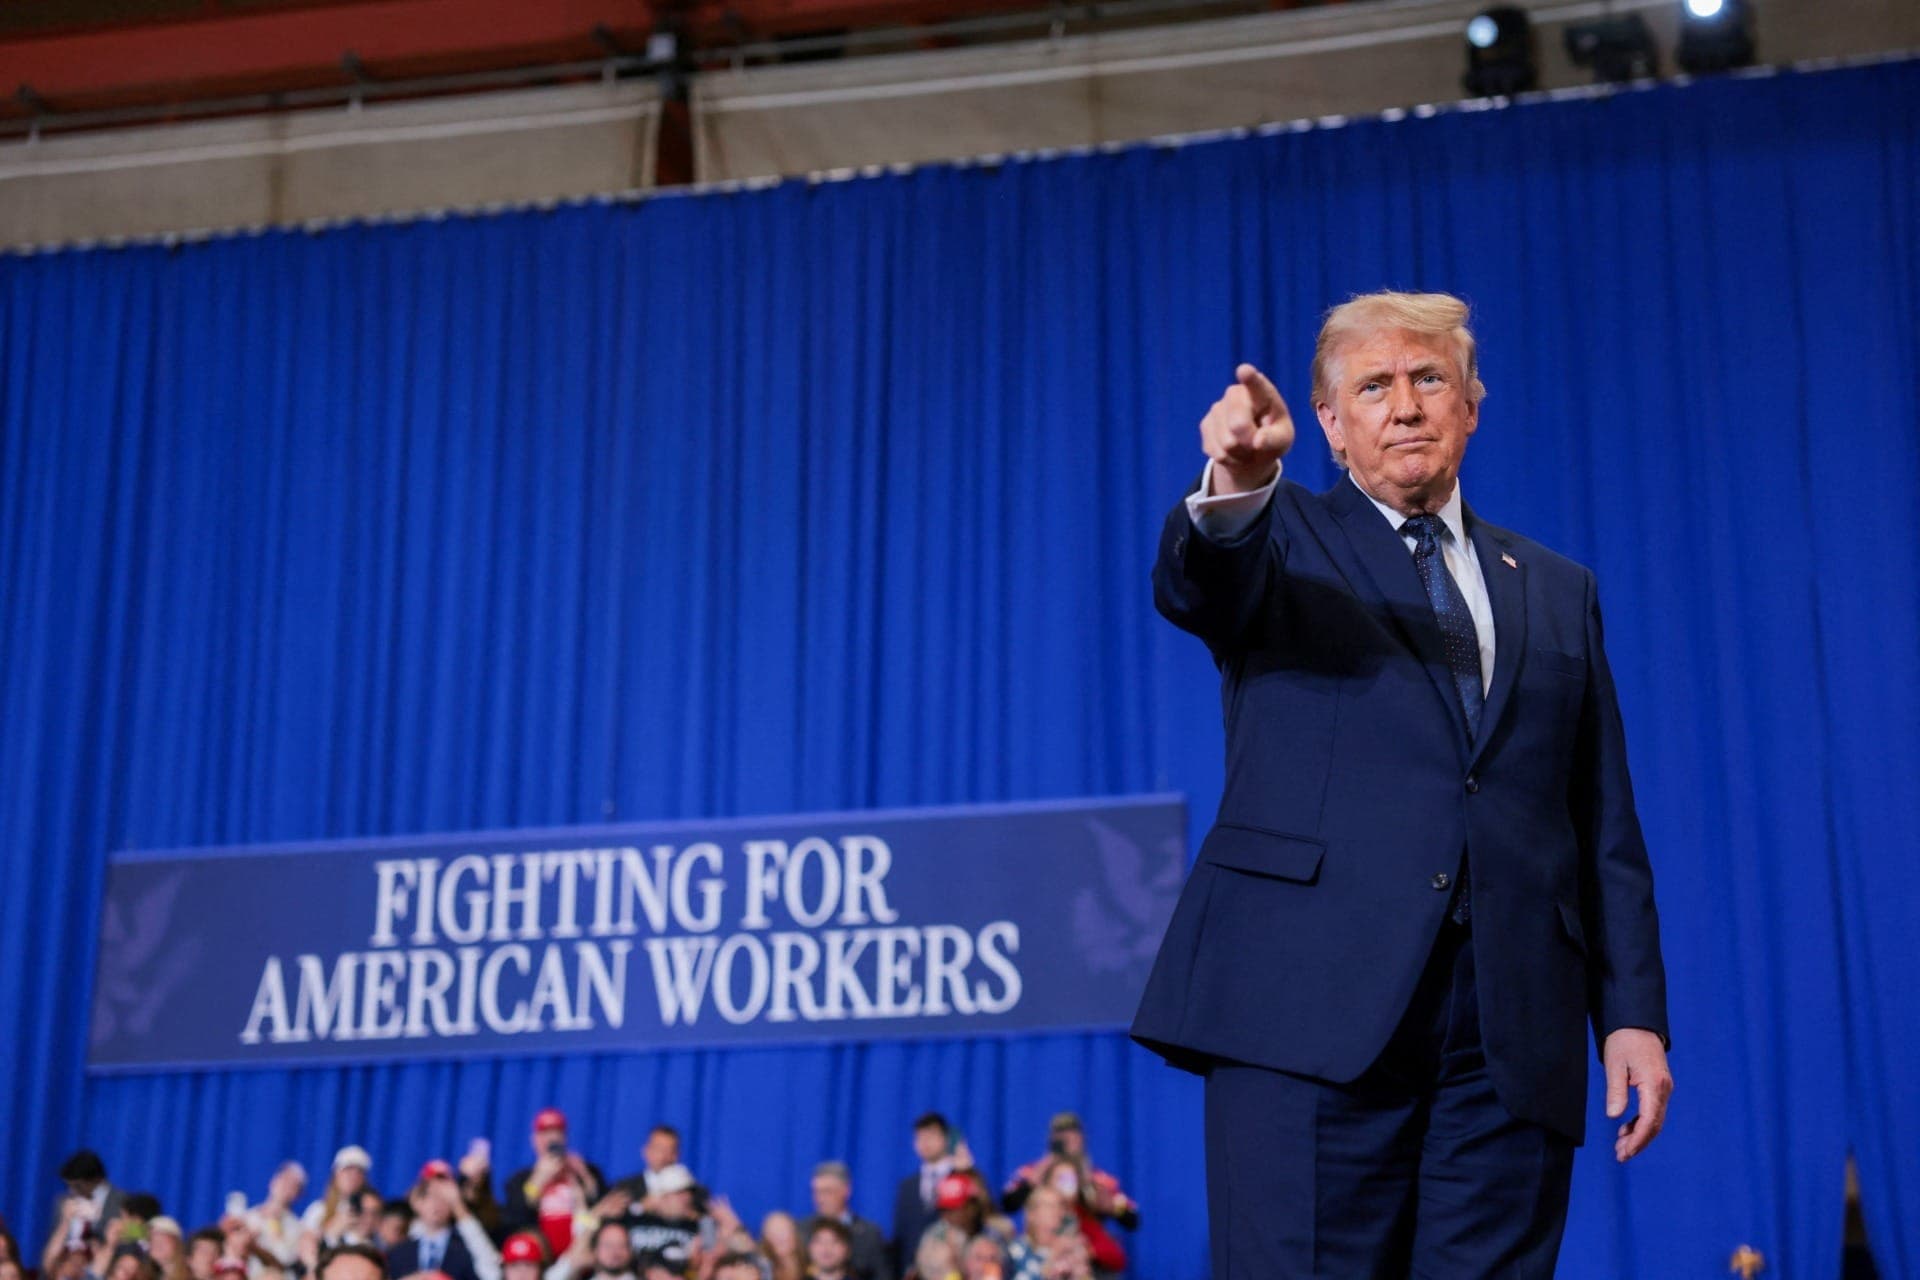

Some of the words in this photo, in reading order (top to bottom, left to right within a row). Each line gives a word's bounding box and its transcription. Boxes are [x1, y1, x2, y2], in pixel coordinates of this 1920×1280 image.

[370, 842, 726, 947] FIGHTING
[741, 835, 899, 930] FOR
[239, 939, 632, 1044] AMERICAN
[644, 920, 1022, 1027] WORKERS
